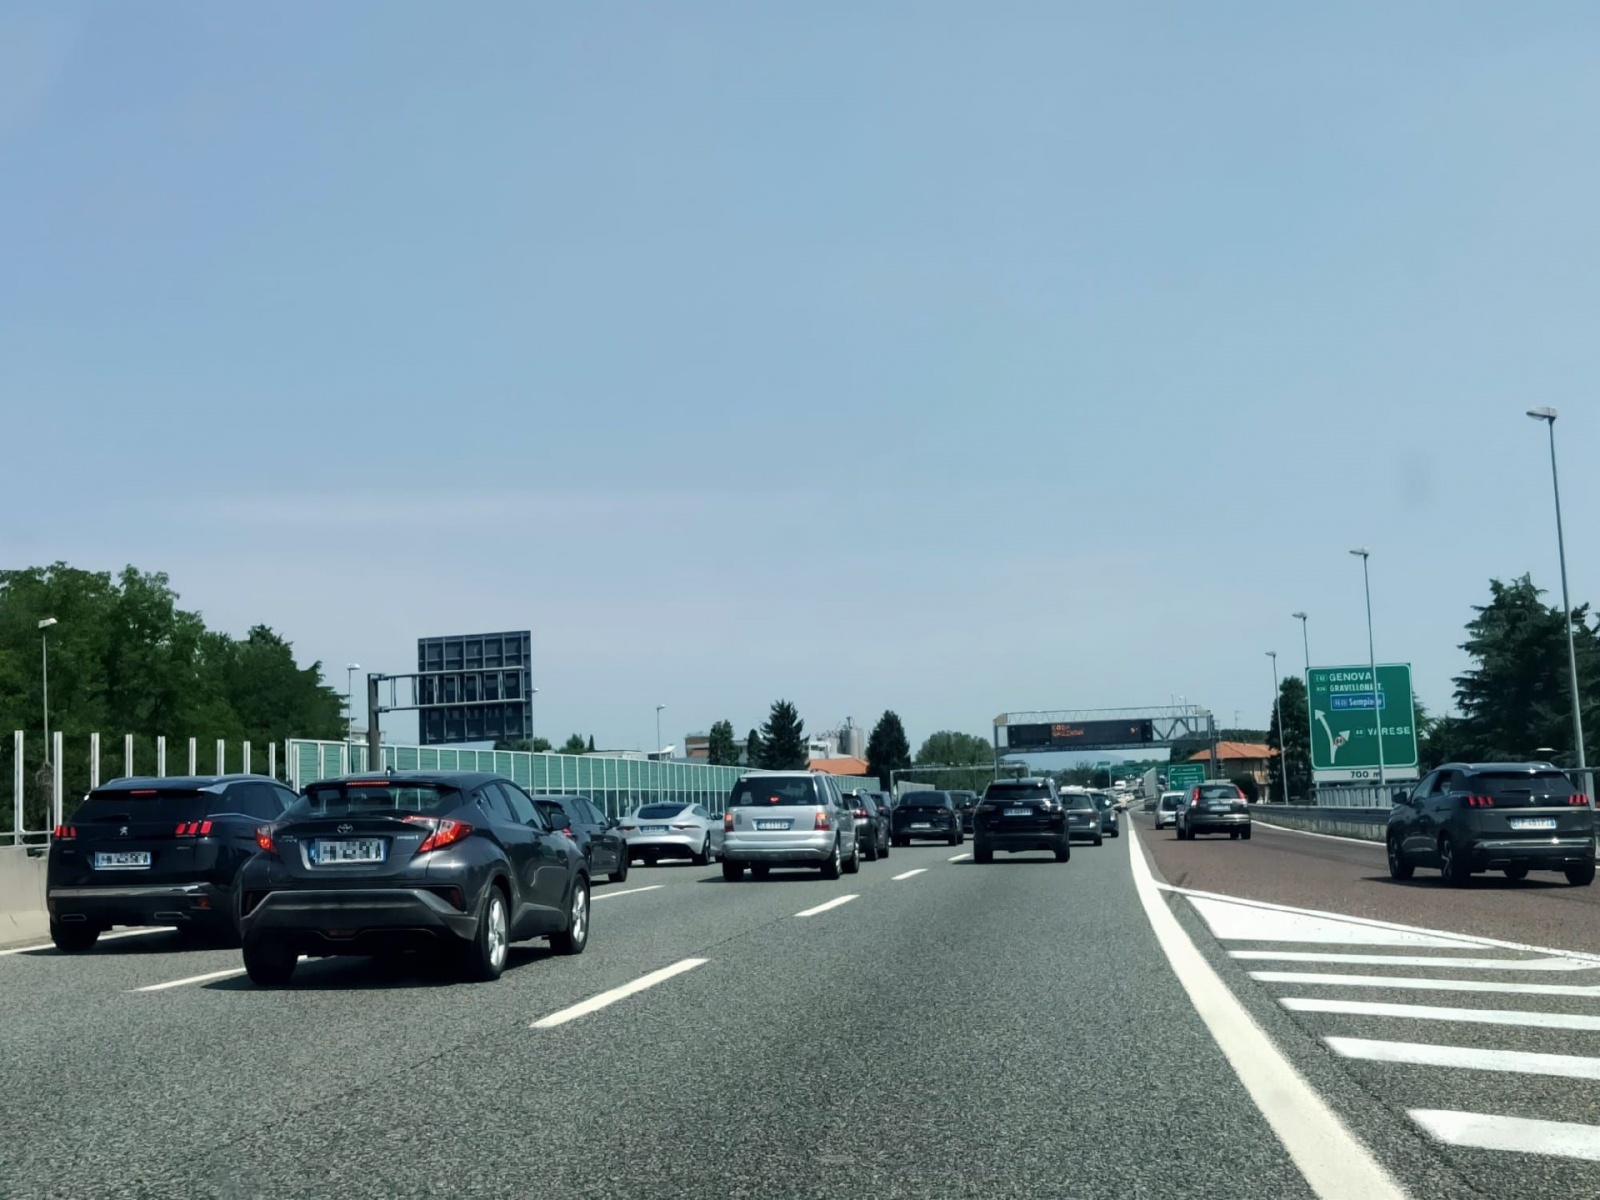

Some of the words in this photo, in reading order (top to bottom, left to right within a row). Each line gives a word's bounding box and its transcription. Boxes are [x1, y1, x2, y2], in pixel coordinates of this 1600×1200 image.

[1329, 672, 1371, 682] GENOVA
[1348, 697, 1382, 707] Sempioe
[1350, 771, 1369, 779] 700
